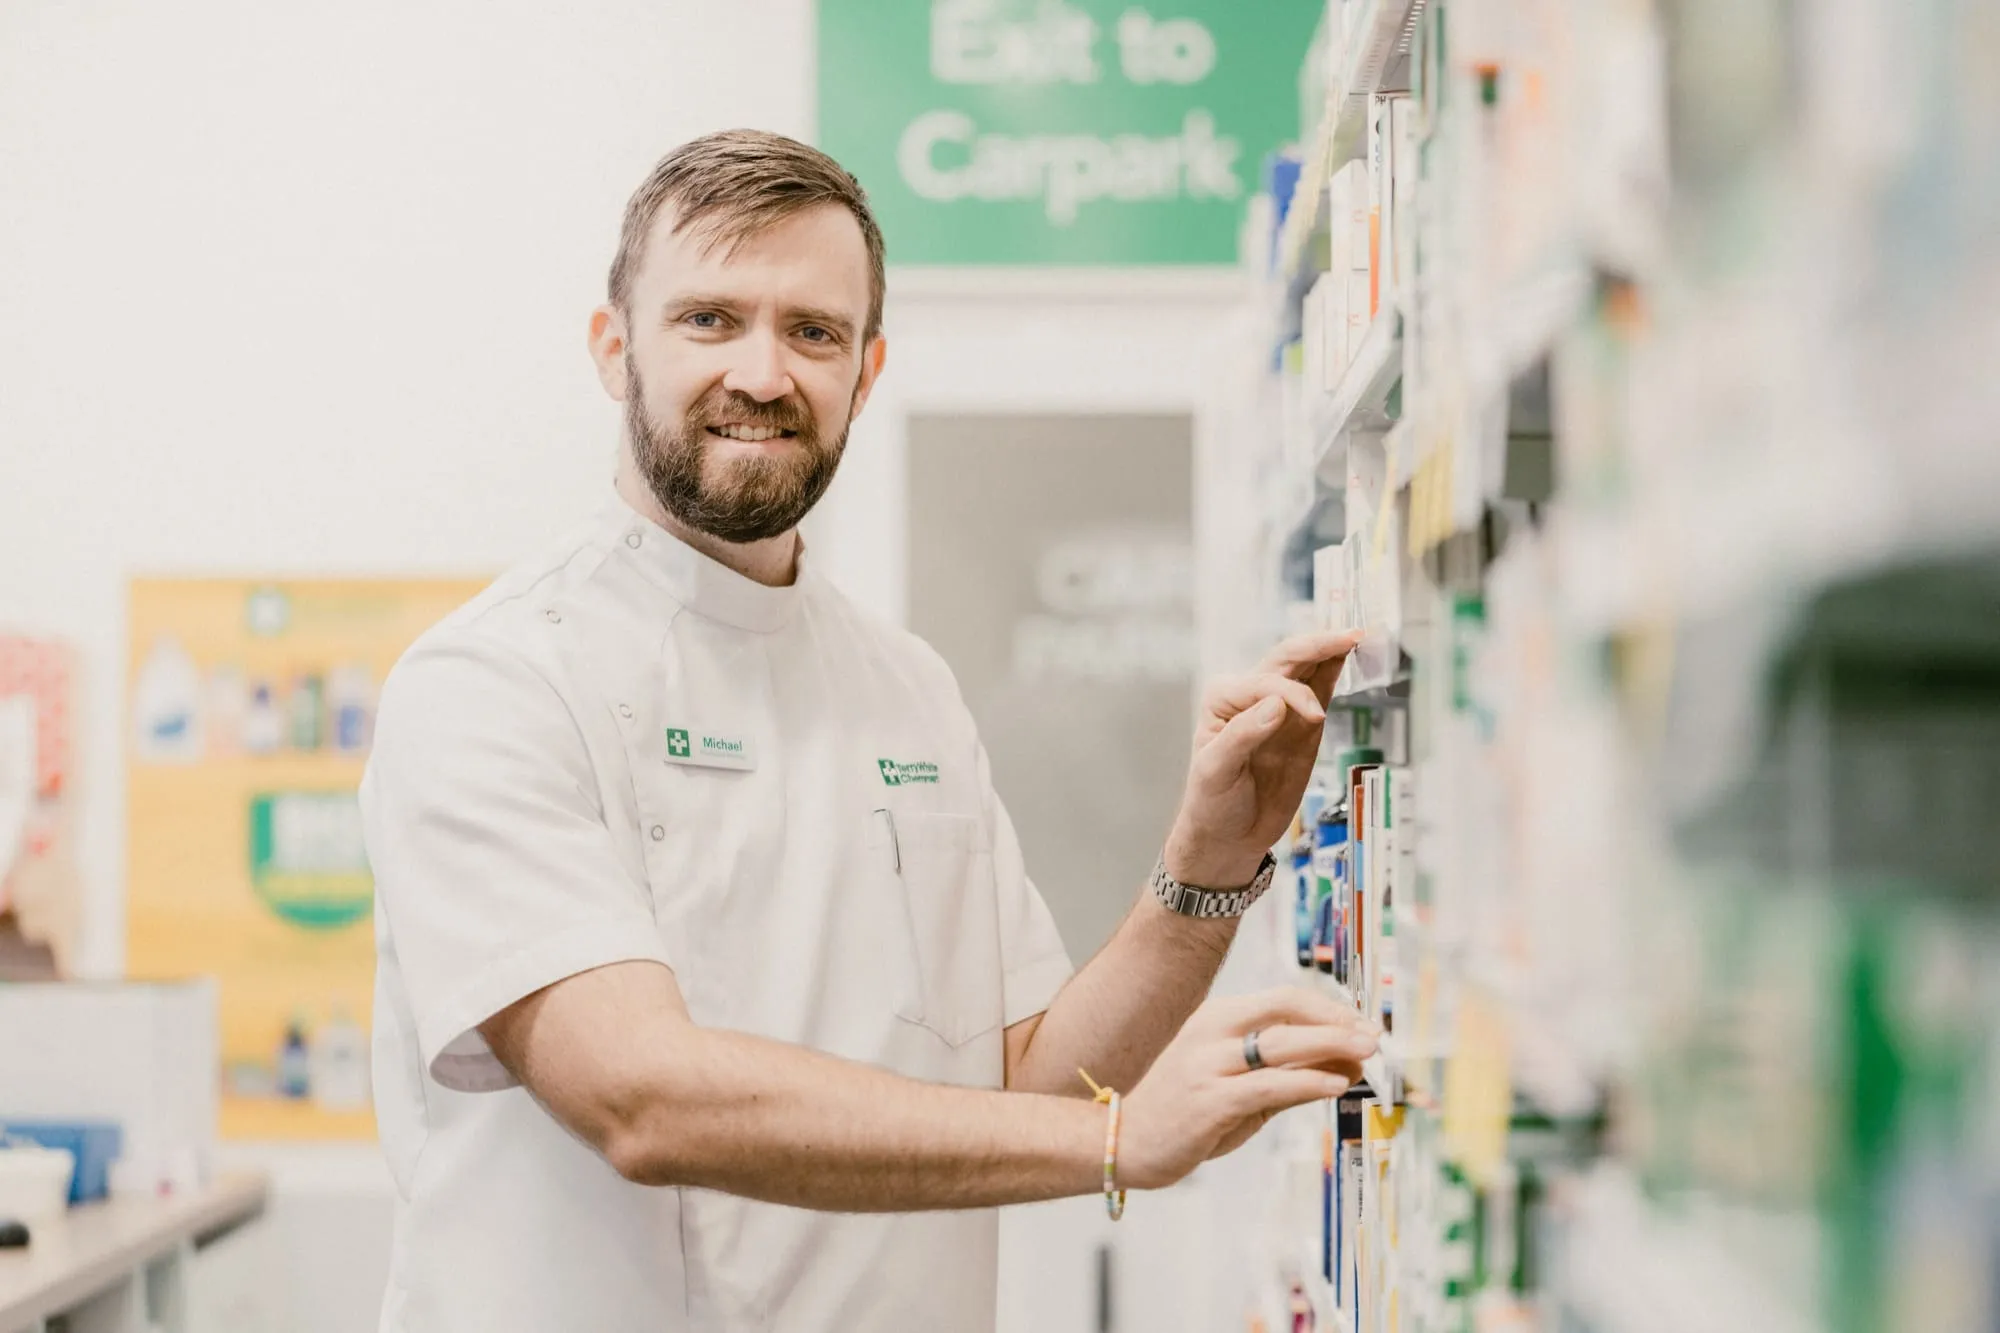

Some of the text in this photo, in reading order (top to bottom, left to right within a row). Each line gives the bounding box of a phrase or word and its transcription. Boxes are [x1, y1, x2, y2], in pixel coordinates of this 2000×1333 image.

[930, 0, 1216, 85] Exit to
[899, 108, 1240, 226] Carpark
[702, 736, 743, 752] Michael
